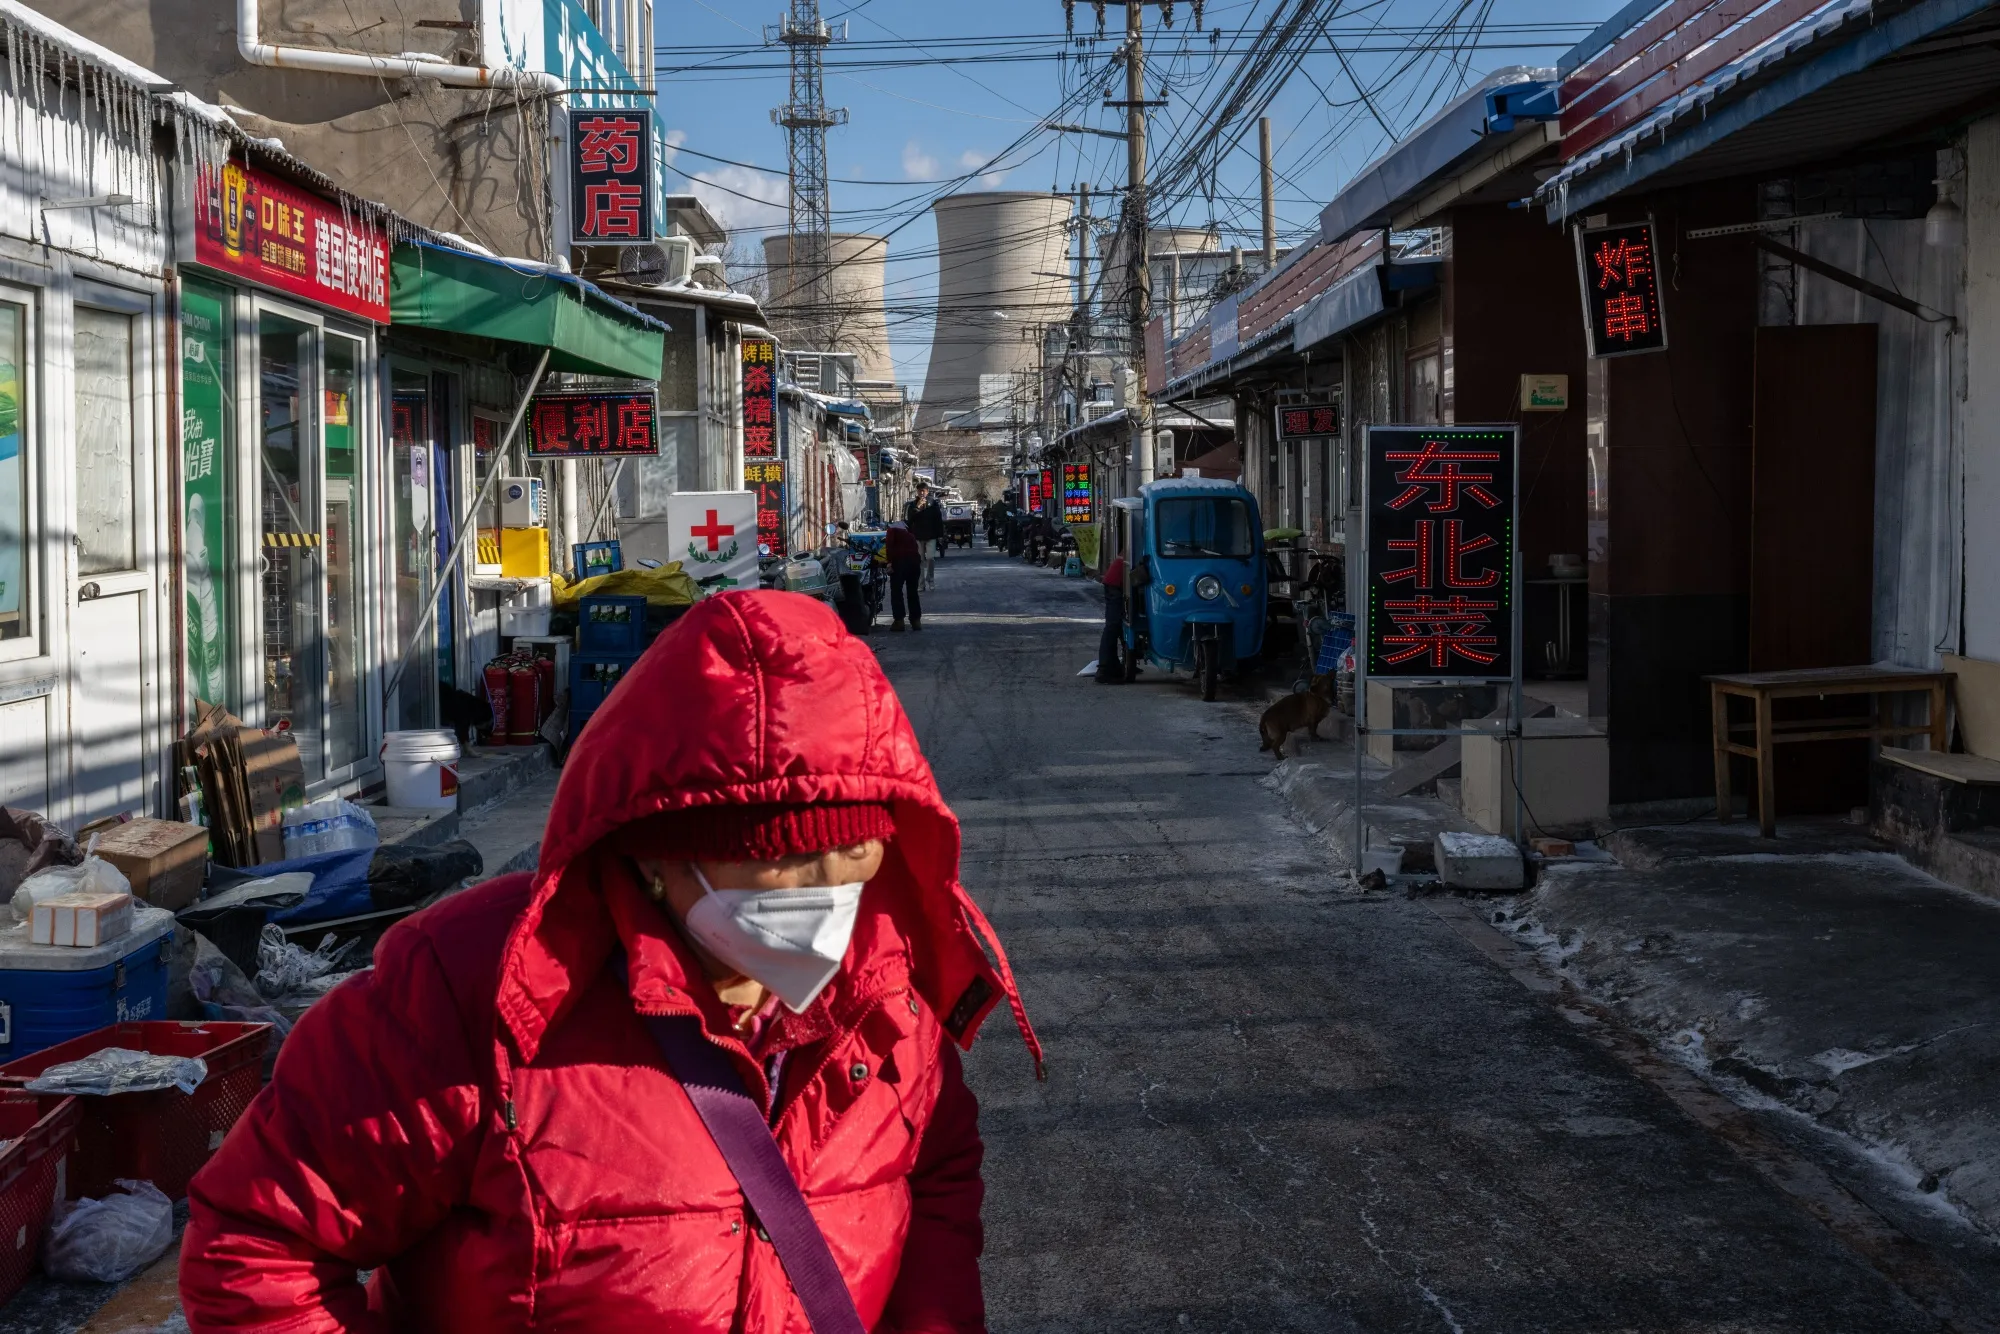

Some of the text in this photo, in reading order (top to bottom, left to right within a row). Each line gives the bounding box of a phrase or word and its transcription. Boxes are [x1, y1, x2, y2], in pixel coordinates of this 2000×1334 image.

[578, 117, 642, 237] 药店
[261, 195, 306, 244] 口味王
[314, 216, 386, 307] 建国便利店
[1593, 238, 1649, 342] 炸串
[742, 342, 774, 364] 烤串
[183, 408, 203, 442] 我的
[531, 399, 652, 452] 便利店
[743, 364, 773, 454] 杀猪菜
[1285, 408, 1337, 434] 理发
[1065, 481, 1089, 490] 炒面
[1378, 440, 1503, 668] 东北菜
